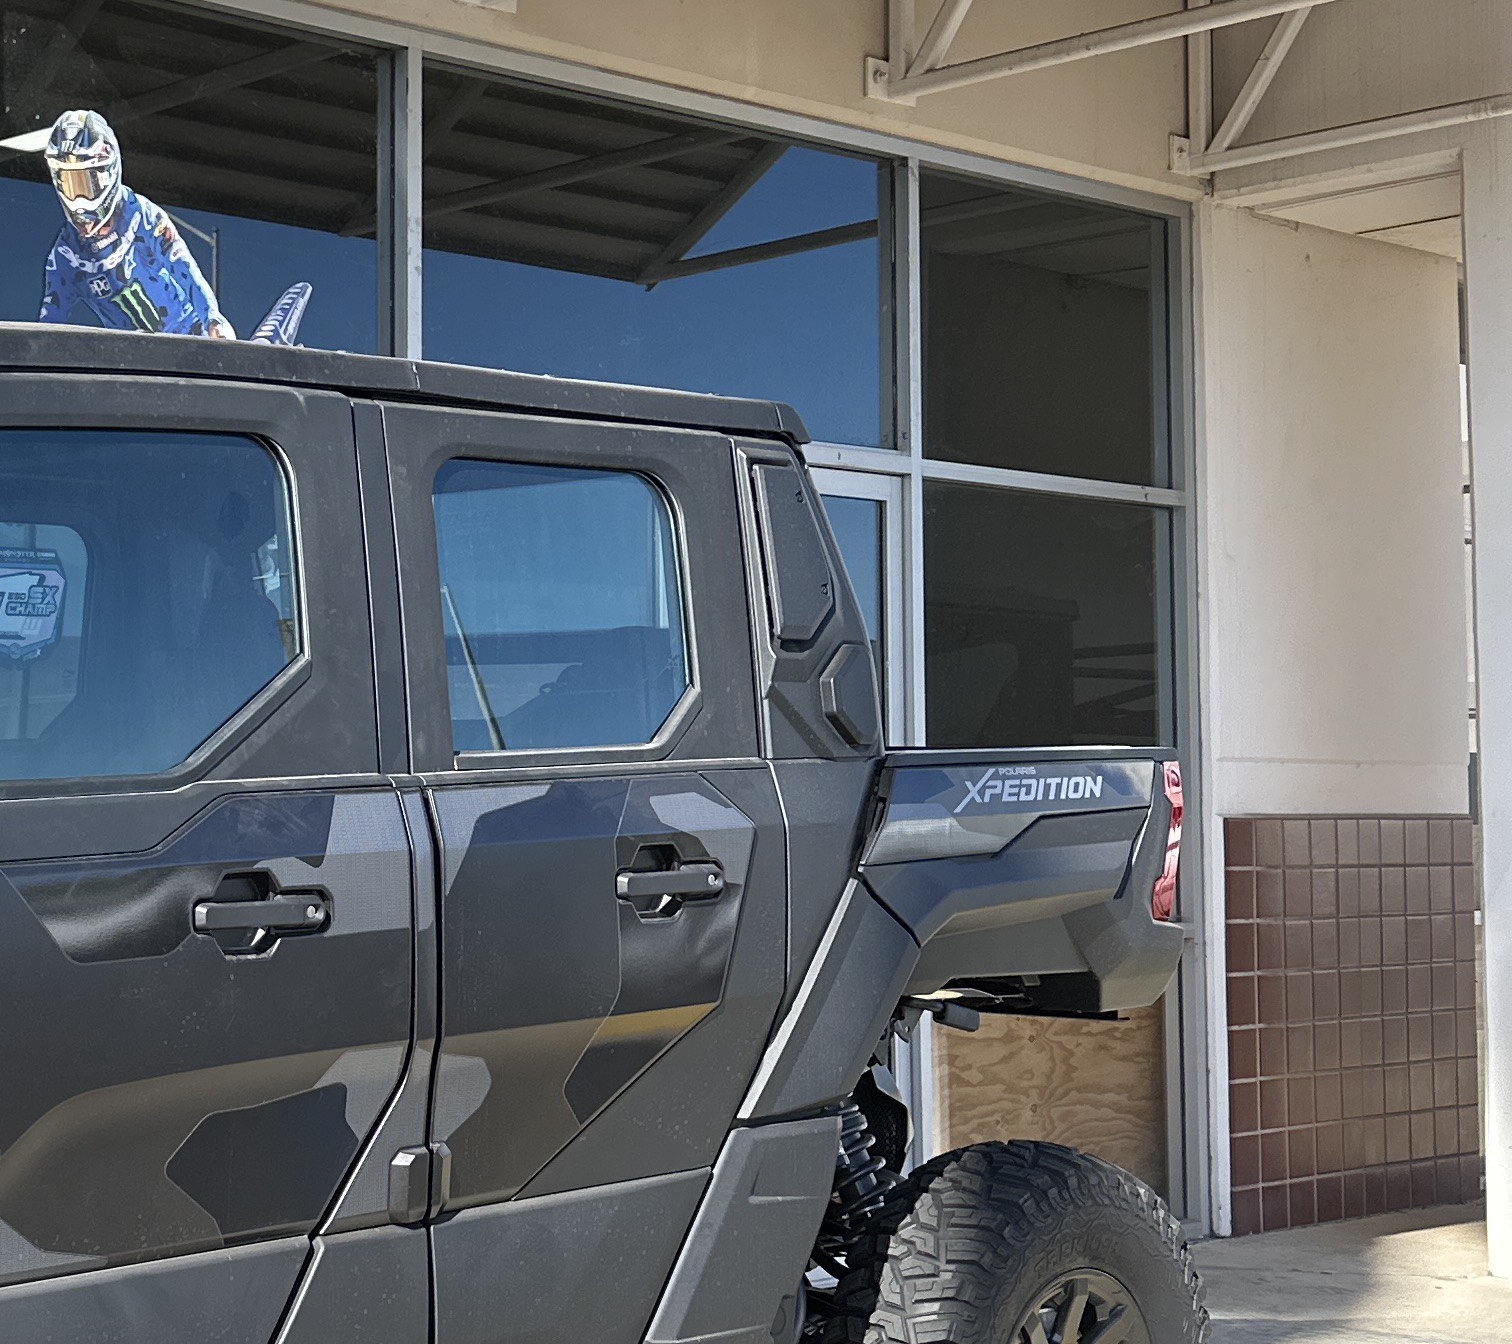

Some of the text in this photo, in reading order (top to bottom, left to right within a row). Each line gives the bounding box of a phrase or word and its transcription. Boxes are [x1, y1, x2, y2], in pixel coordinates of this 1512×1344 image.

[29, 587, 58, 604] SX
[7, 602, 56, 615] CHAMP
[998, 767, 1037, 776] POLARIS
[953, 768, 1103, 813] XPEDITION
